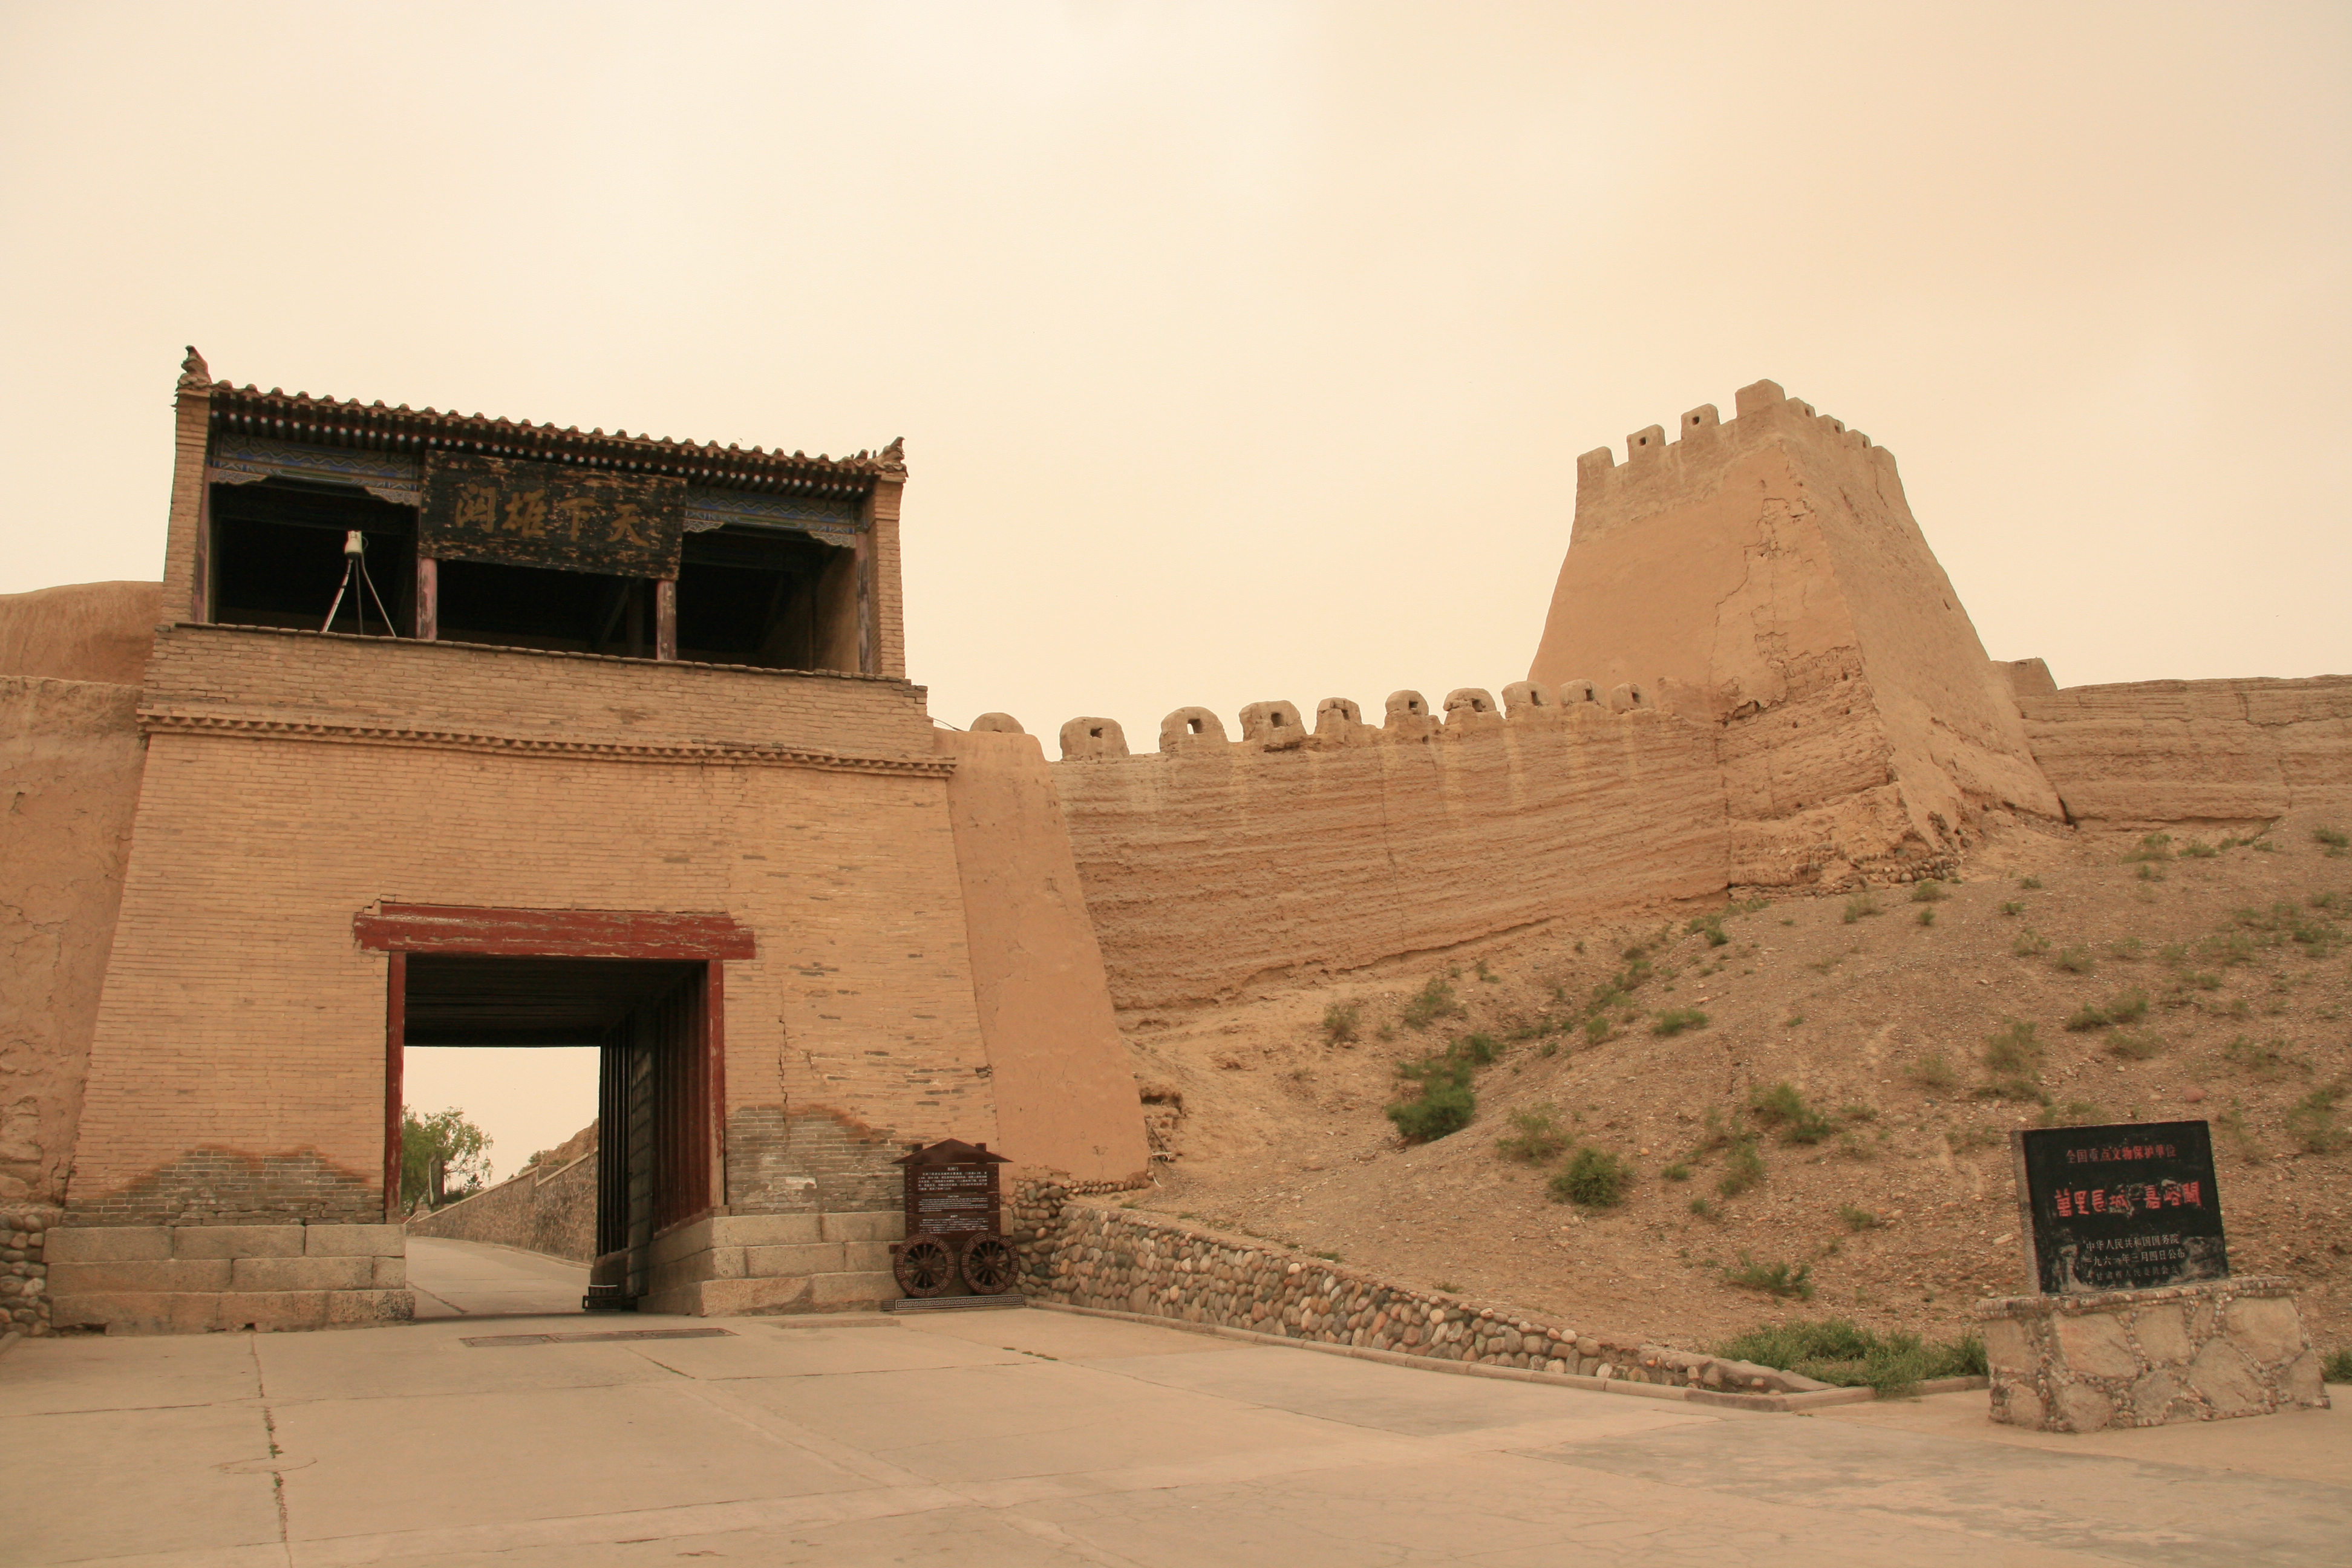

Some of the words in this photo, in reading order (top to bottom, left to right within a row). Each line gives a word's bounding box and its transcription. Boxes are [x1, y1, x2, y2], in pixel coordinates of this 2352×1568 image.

[2066, 1145, 2177, 1163] 全国重点文物保护单位
[2086, 1233, 2179, 1251] 中华人民共和国国务院
[2085, 1248, 2185, 1266] 一九六一年三月四日公布
